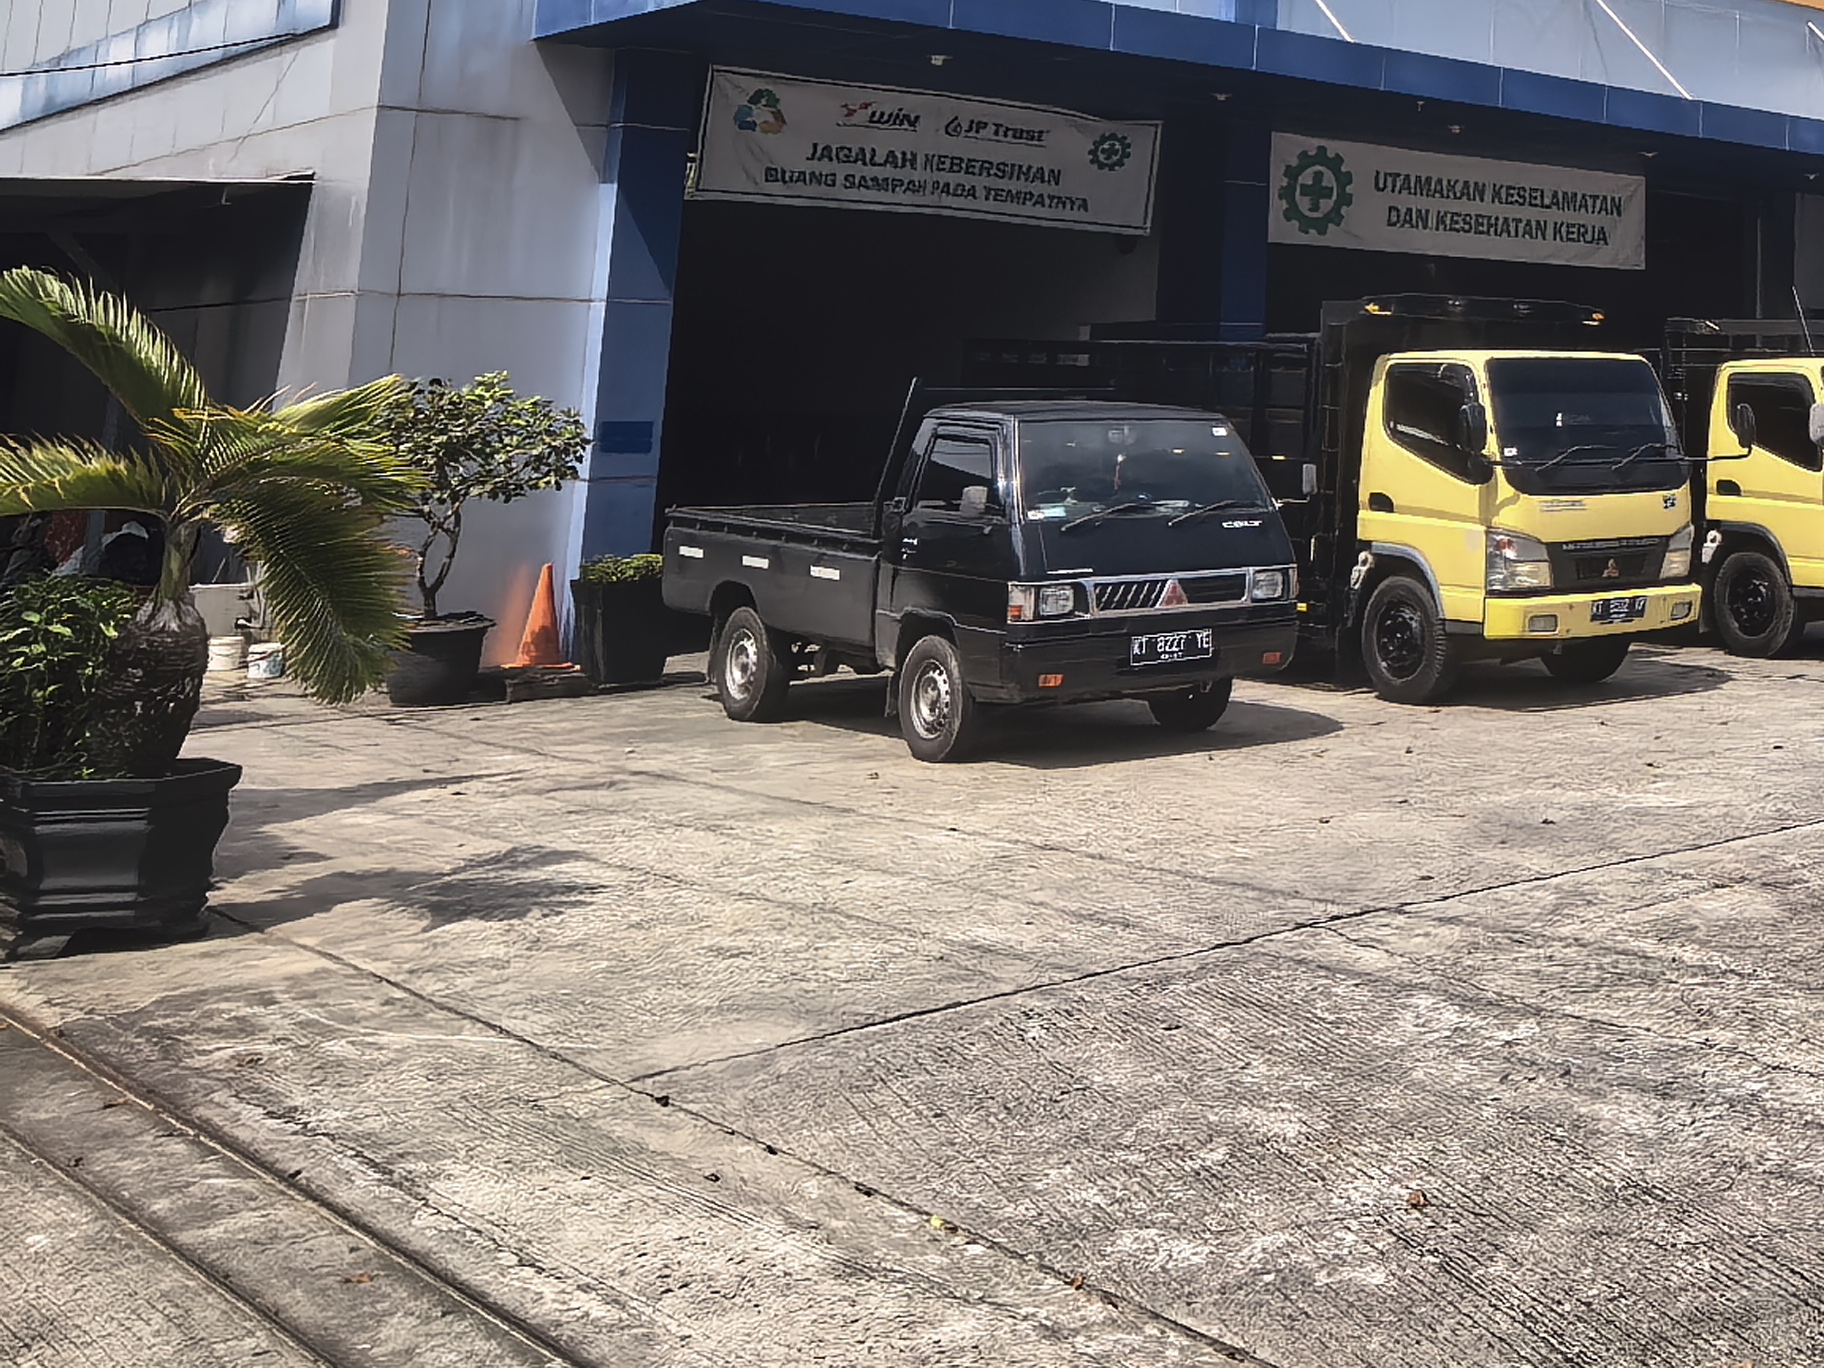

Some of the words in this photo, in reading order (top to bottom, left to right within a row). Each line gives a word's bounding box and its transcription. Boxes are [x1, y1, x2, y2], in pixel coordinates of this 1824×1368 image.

[806, 143, 918, 171] JAGALAH
[924, 153, 1061, 186] KEBERSIHAN
[765, 166, 837, 187] BUANG
[843, 174, 927, 196] SAMPAH
[931, 179, 977, 200] PADA
[983, 186, 1089, 213] TEMPATNYA
[1374, 169, 1487, 203] UTAMAKAN
[1491, 182, 1622, 217] KESELAMATAN
[1386, 205, 1430, 230] DAN
[1435, 210, 1547, 240] KESEHATAN
[1553, 220, 1609, 246] KERJA
